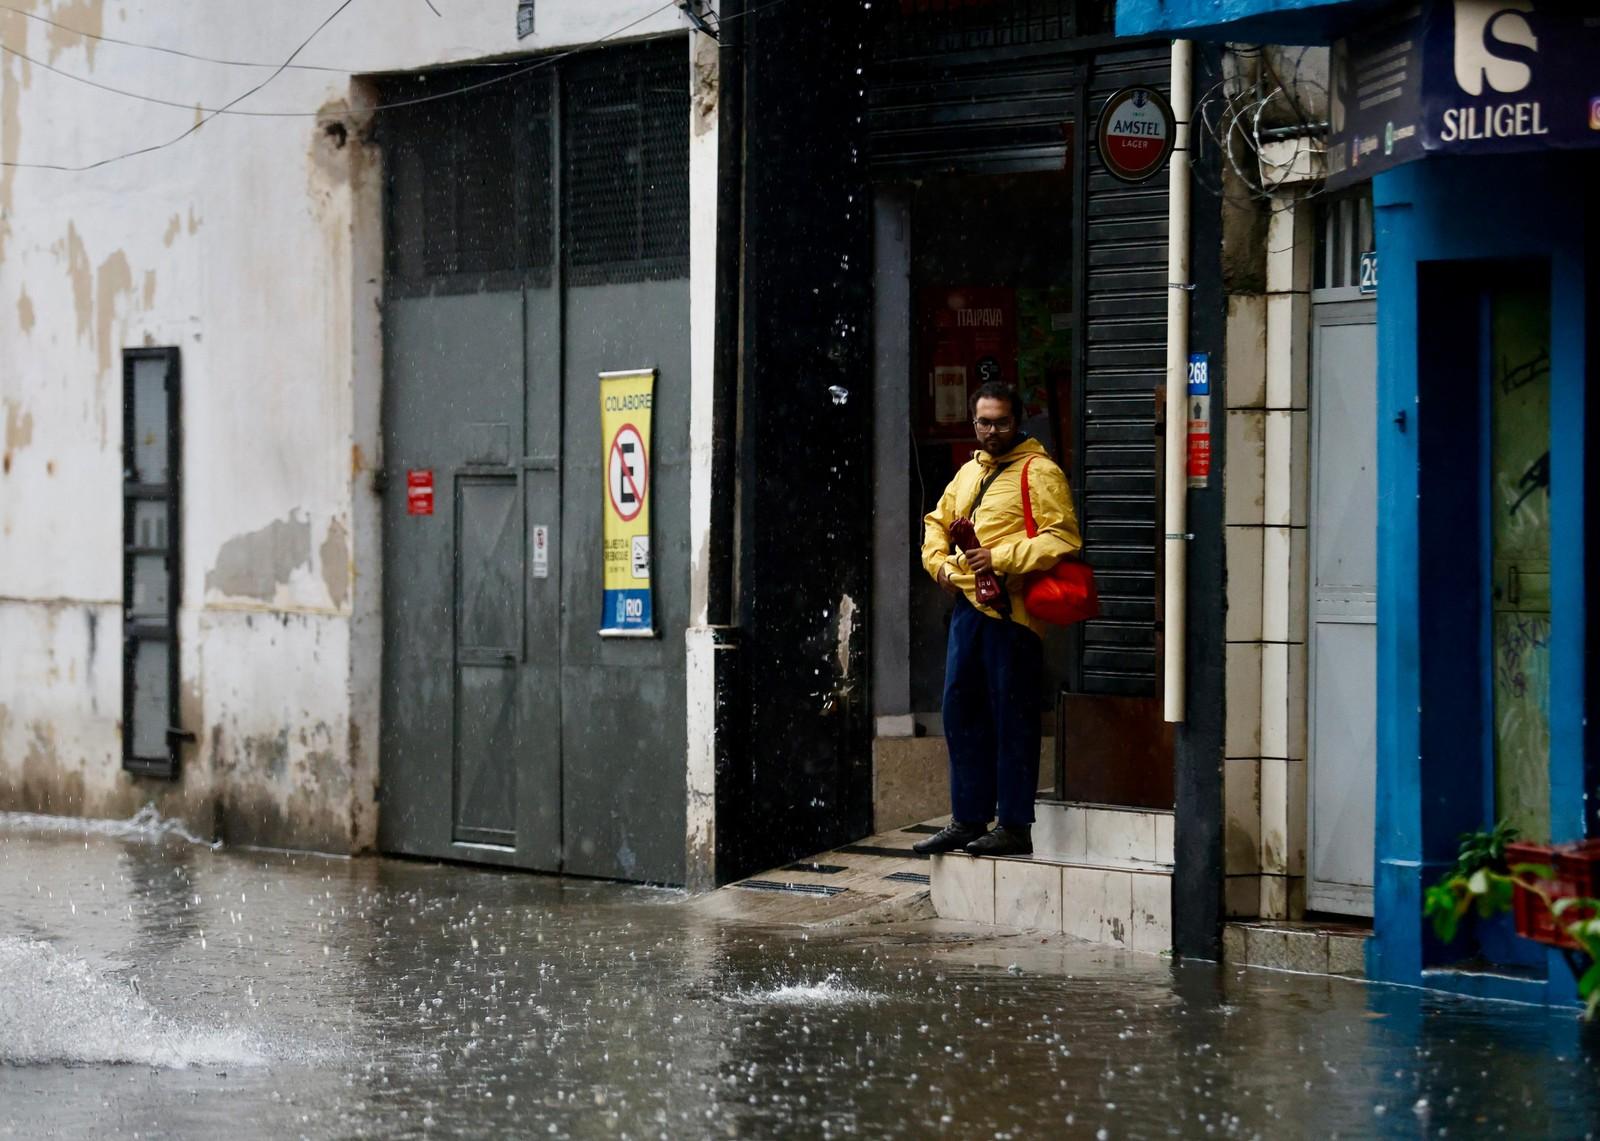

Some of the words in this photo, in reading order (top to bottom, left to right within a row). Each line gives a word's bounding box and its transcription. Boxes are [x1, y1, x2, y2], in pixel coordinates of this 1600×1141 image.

[1113, 119, 1161, 136] AMSTEL
[1440, 102, 1549, 142] SILIGEL
[1121, 139, 1149, 149] LAGER
[957, 308, 1003, 327] ITAIPAVA
[1188, 361, 1208, 384] 268
[605, 393, 653, 412] COLABORE
[626, 598, 643, 617] RIO
